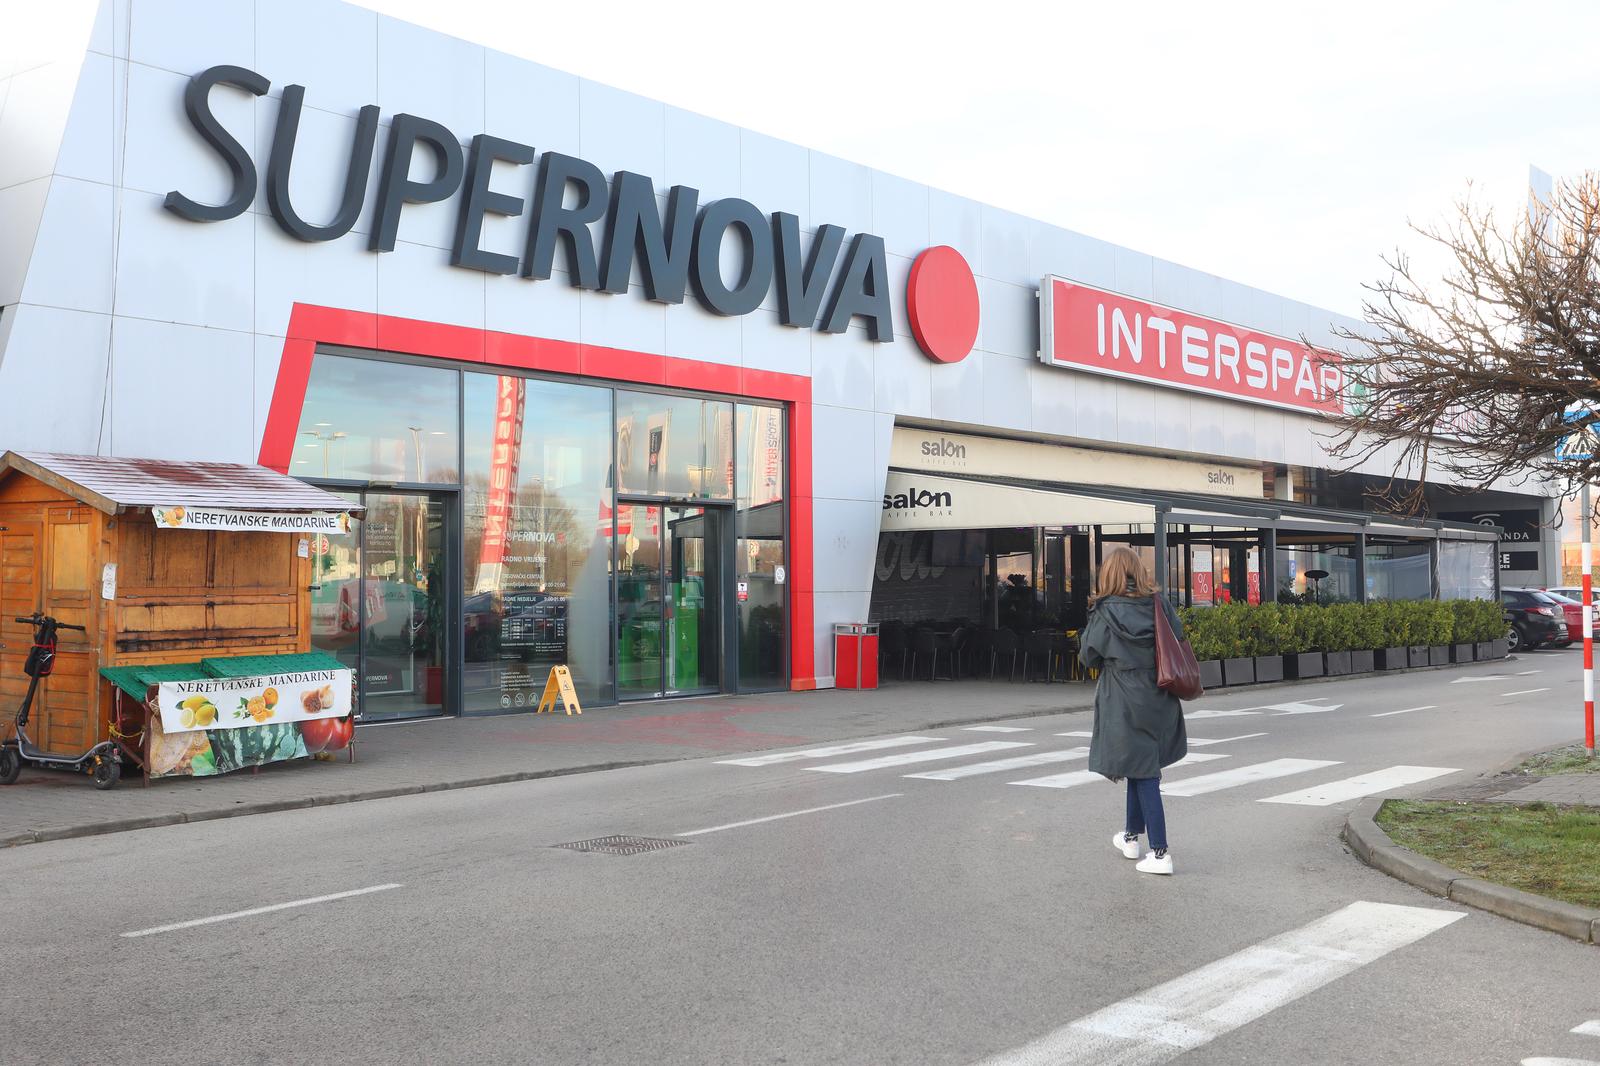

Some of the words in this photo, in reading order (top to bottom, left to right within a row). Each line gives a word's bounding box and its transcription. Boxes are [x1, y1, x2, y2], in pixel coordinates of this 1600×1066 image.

[163, 65, 895, 344] SUPERNOVA
[1097, 303, 1342, 402] INTERSPAR
[921, 437, 966, 459] salon
[1207, 469, 1234, 485] salon
[883, 487, 952, 510] salon
[185, 511, 269, 528] NERETVANSKE
[271, 516, 337, 529] MANDARINE
[502, 530, 556, 544] SUPERNOVA
[177, 678, 264, 693] NERETVANSKE
[268, 671, 336, 686] MANDARINE
